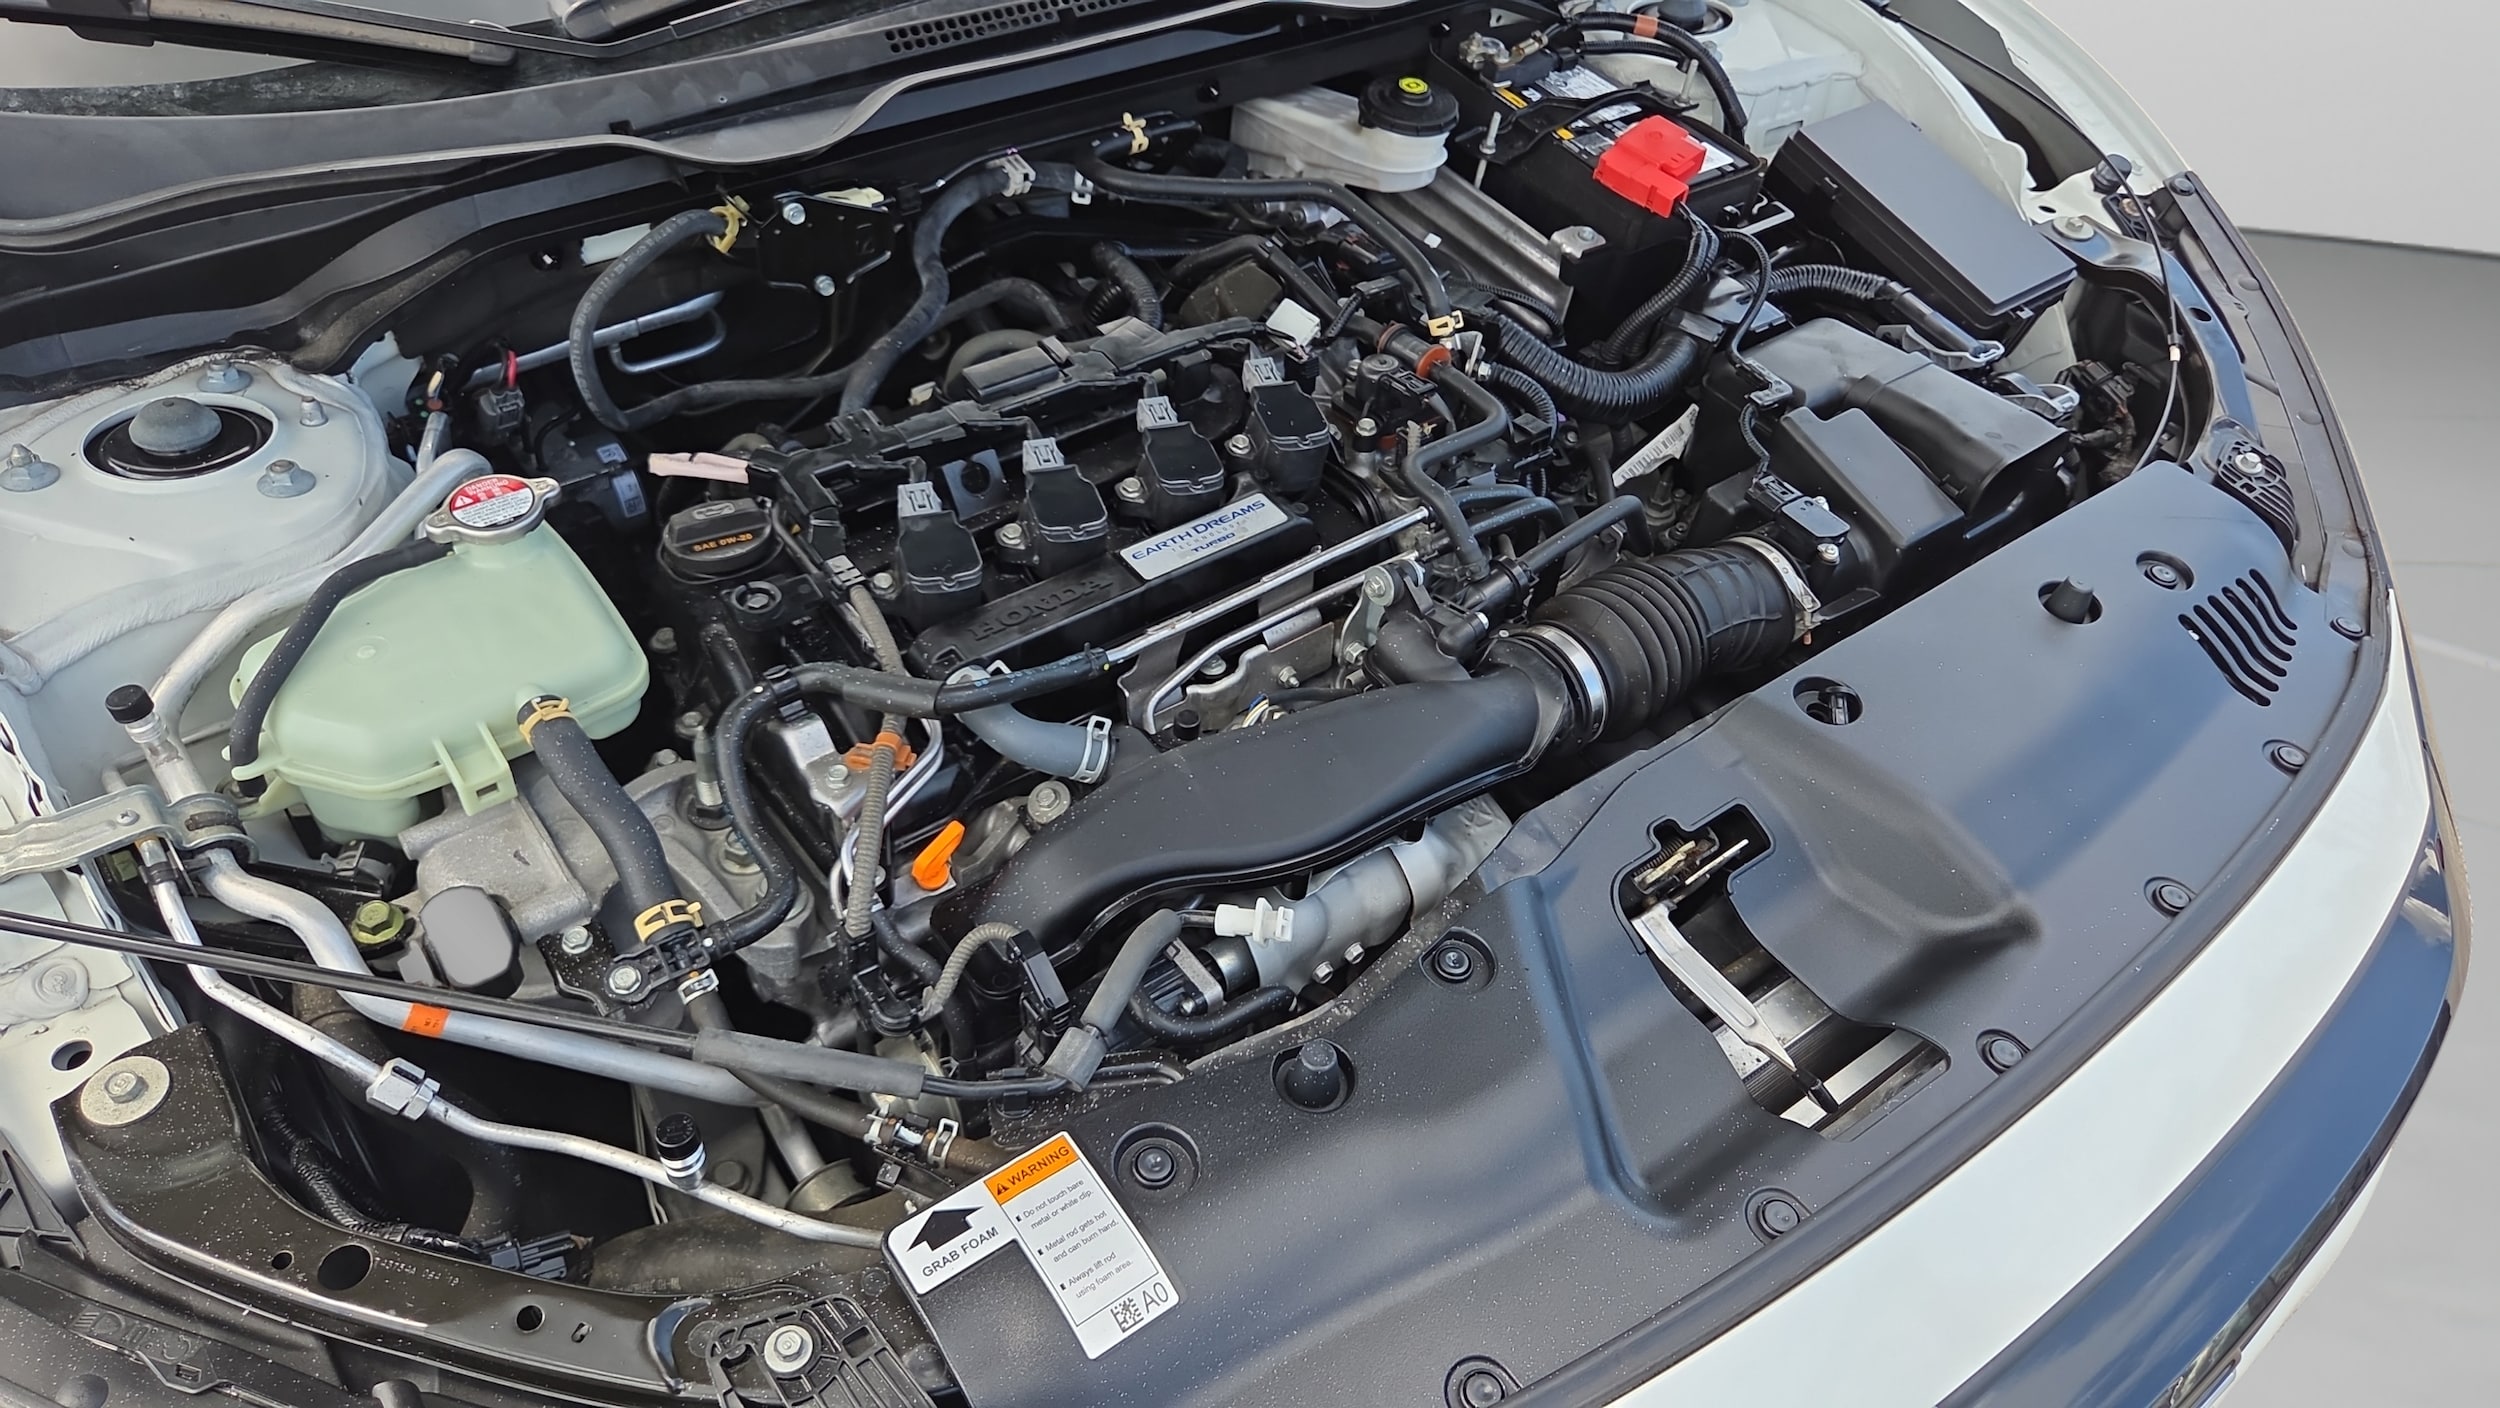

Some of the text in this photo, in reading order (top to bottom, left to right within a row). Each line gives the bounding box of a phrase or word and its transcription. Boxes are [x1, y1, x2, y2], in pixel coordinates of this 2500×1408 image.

[693, 533, 753, 552] SAE 0W-20
[1131, 500, 1265, 560] EARTH DREAMS
[1171, 520, 1241, 552] TECHNOLOGY
[1191, 532, 1236, 553] TURBO
[967, 578, 1114, 641] HONDA
[1008, 1146, 1069, 1185] WARNING
[1022, 1180, 1084, 1218] Do not touch bare
[1031, 1213, 1052, 1229] metal
[1051, 1209, 1060, 1217] or
[1060, 1198, 1079, 1212] white
[1045, 1210, 1107, 1251] Metal rod gets hot
[1053, 1250, 1068, 1263] and
[1068, 1242, 1082, 1254] can
[1081, 1231, 1099, 1245] burn
[922, 1226, 999, 1277] GRAB FOAM
[1068, 1251, 1117, 1287] Always lift rod
[1076, 1283, 1096, 1298] using
[1096, 1271, 1115, 1286] foam
